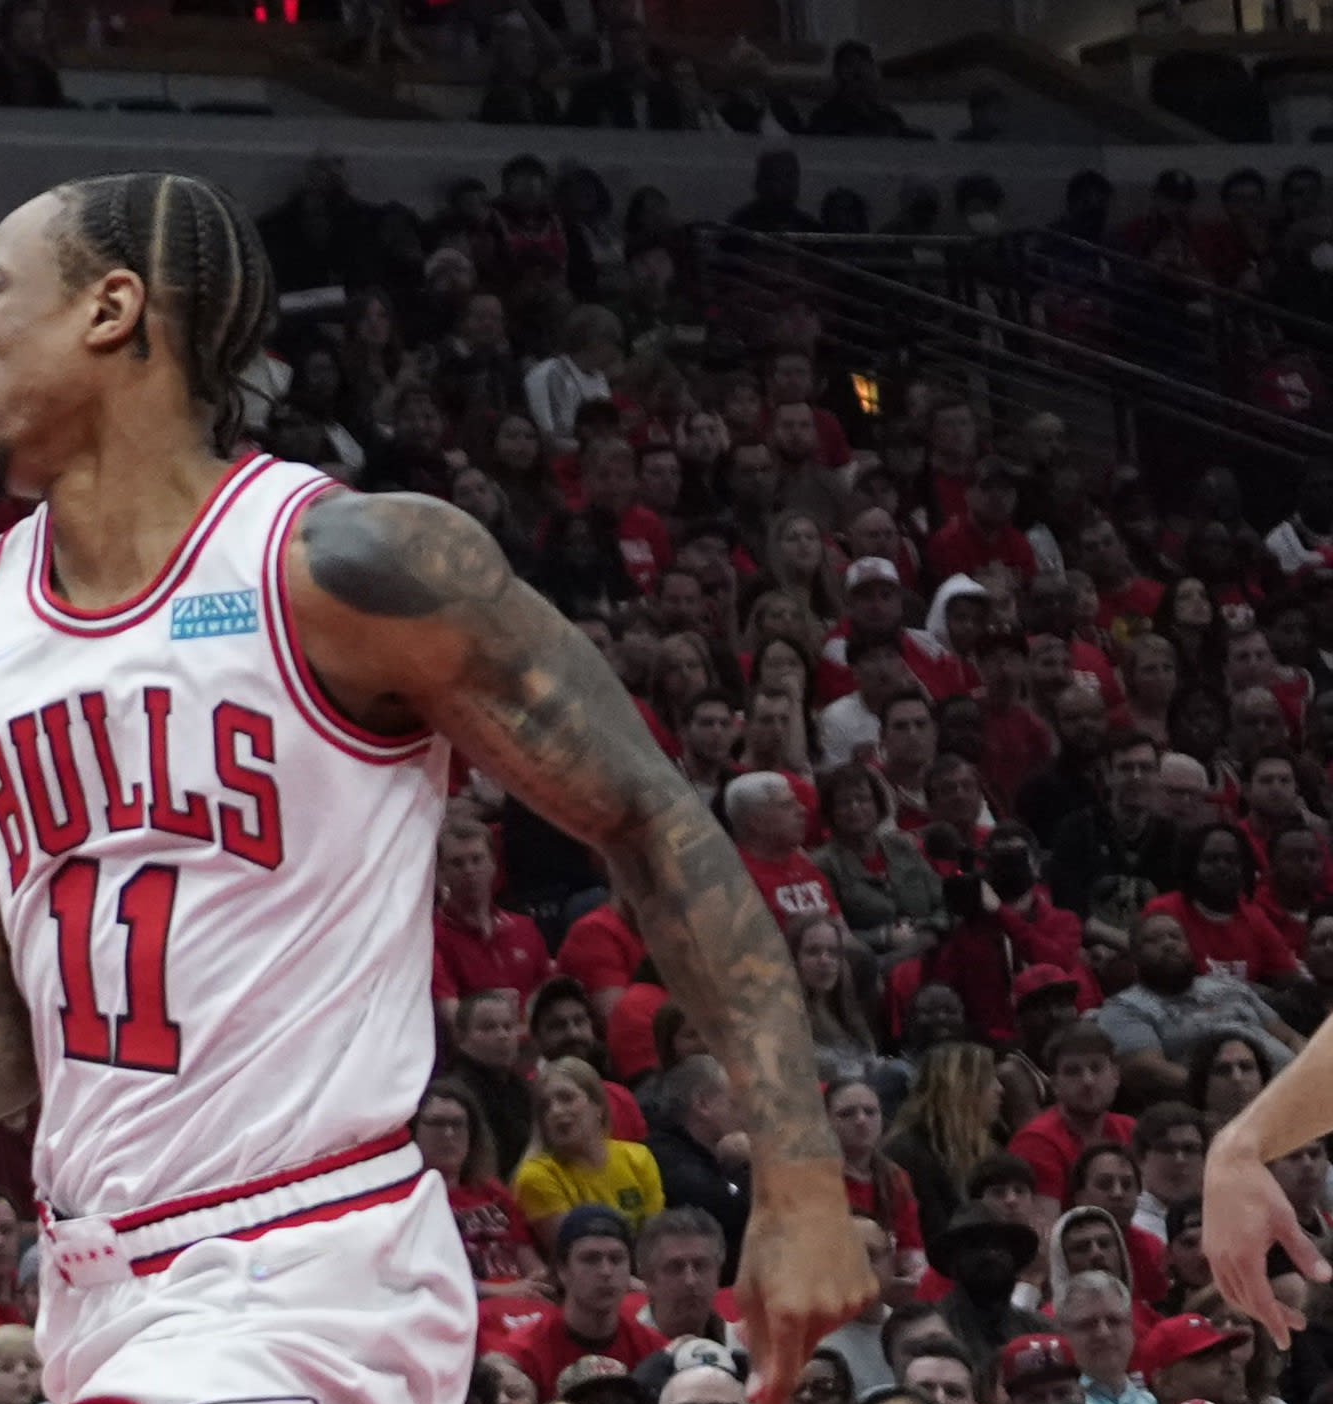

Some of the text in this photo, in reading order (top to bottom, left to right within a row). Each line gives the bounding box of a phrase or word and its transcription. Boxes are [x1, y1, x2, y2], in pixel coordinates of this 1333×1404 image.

[173, 592, 256, 621] ZENNI
[173, 616, 256, 635] EYEWEAR
[49, 856, 181, 1075] 11
